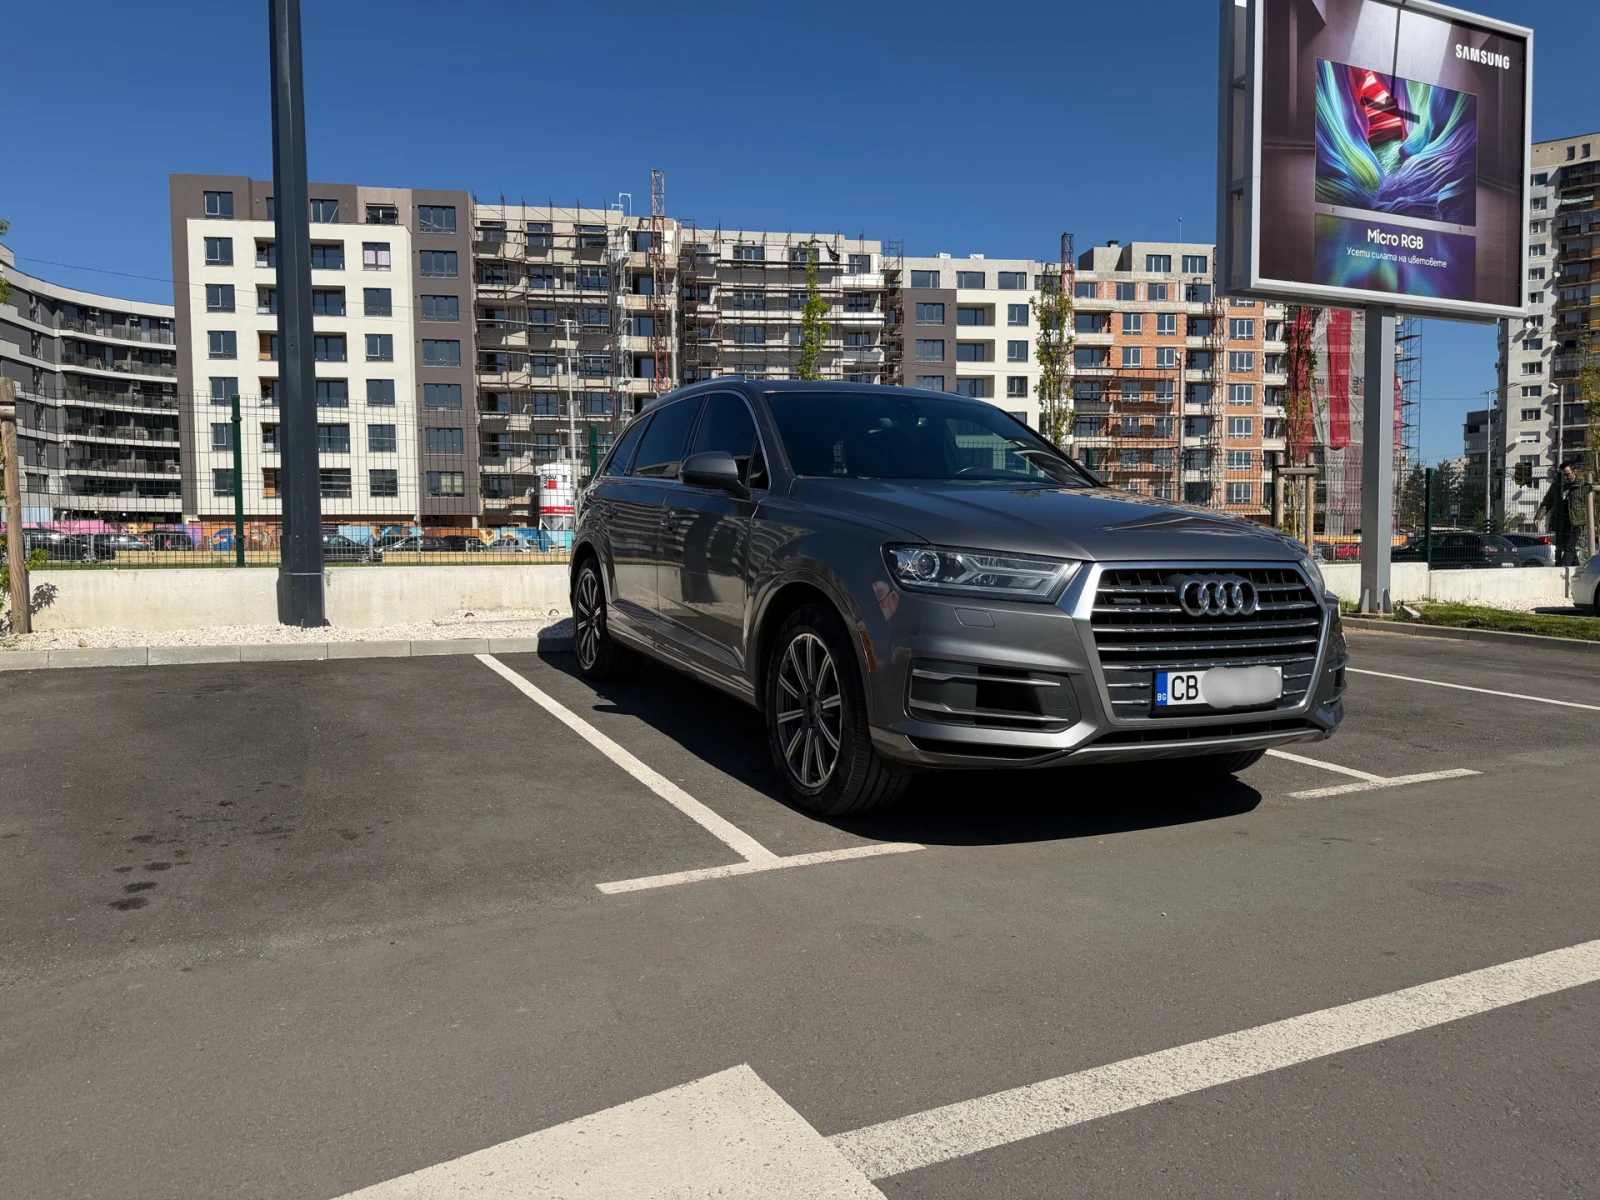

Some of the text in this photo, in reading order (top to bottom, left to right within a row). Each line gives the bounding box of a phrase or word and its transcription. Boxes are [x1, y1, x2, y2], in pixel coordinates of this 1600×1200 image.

[1455, 43, 1510, 70] SAMSUNG
[1367, 228, 1424, 250] Micro RGB
[1346, 246, 1447, 268] Усети силата на цветовете
[1157, 675, 1199, 701] BG CB
